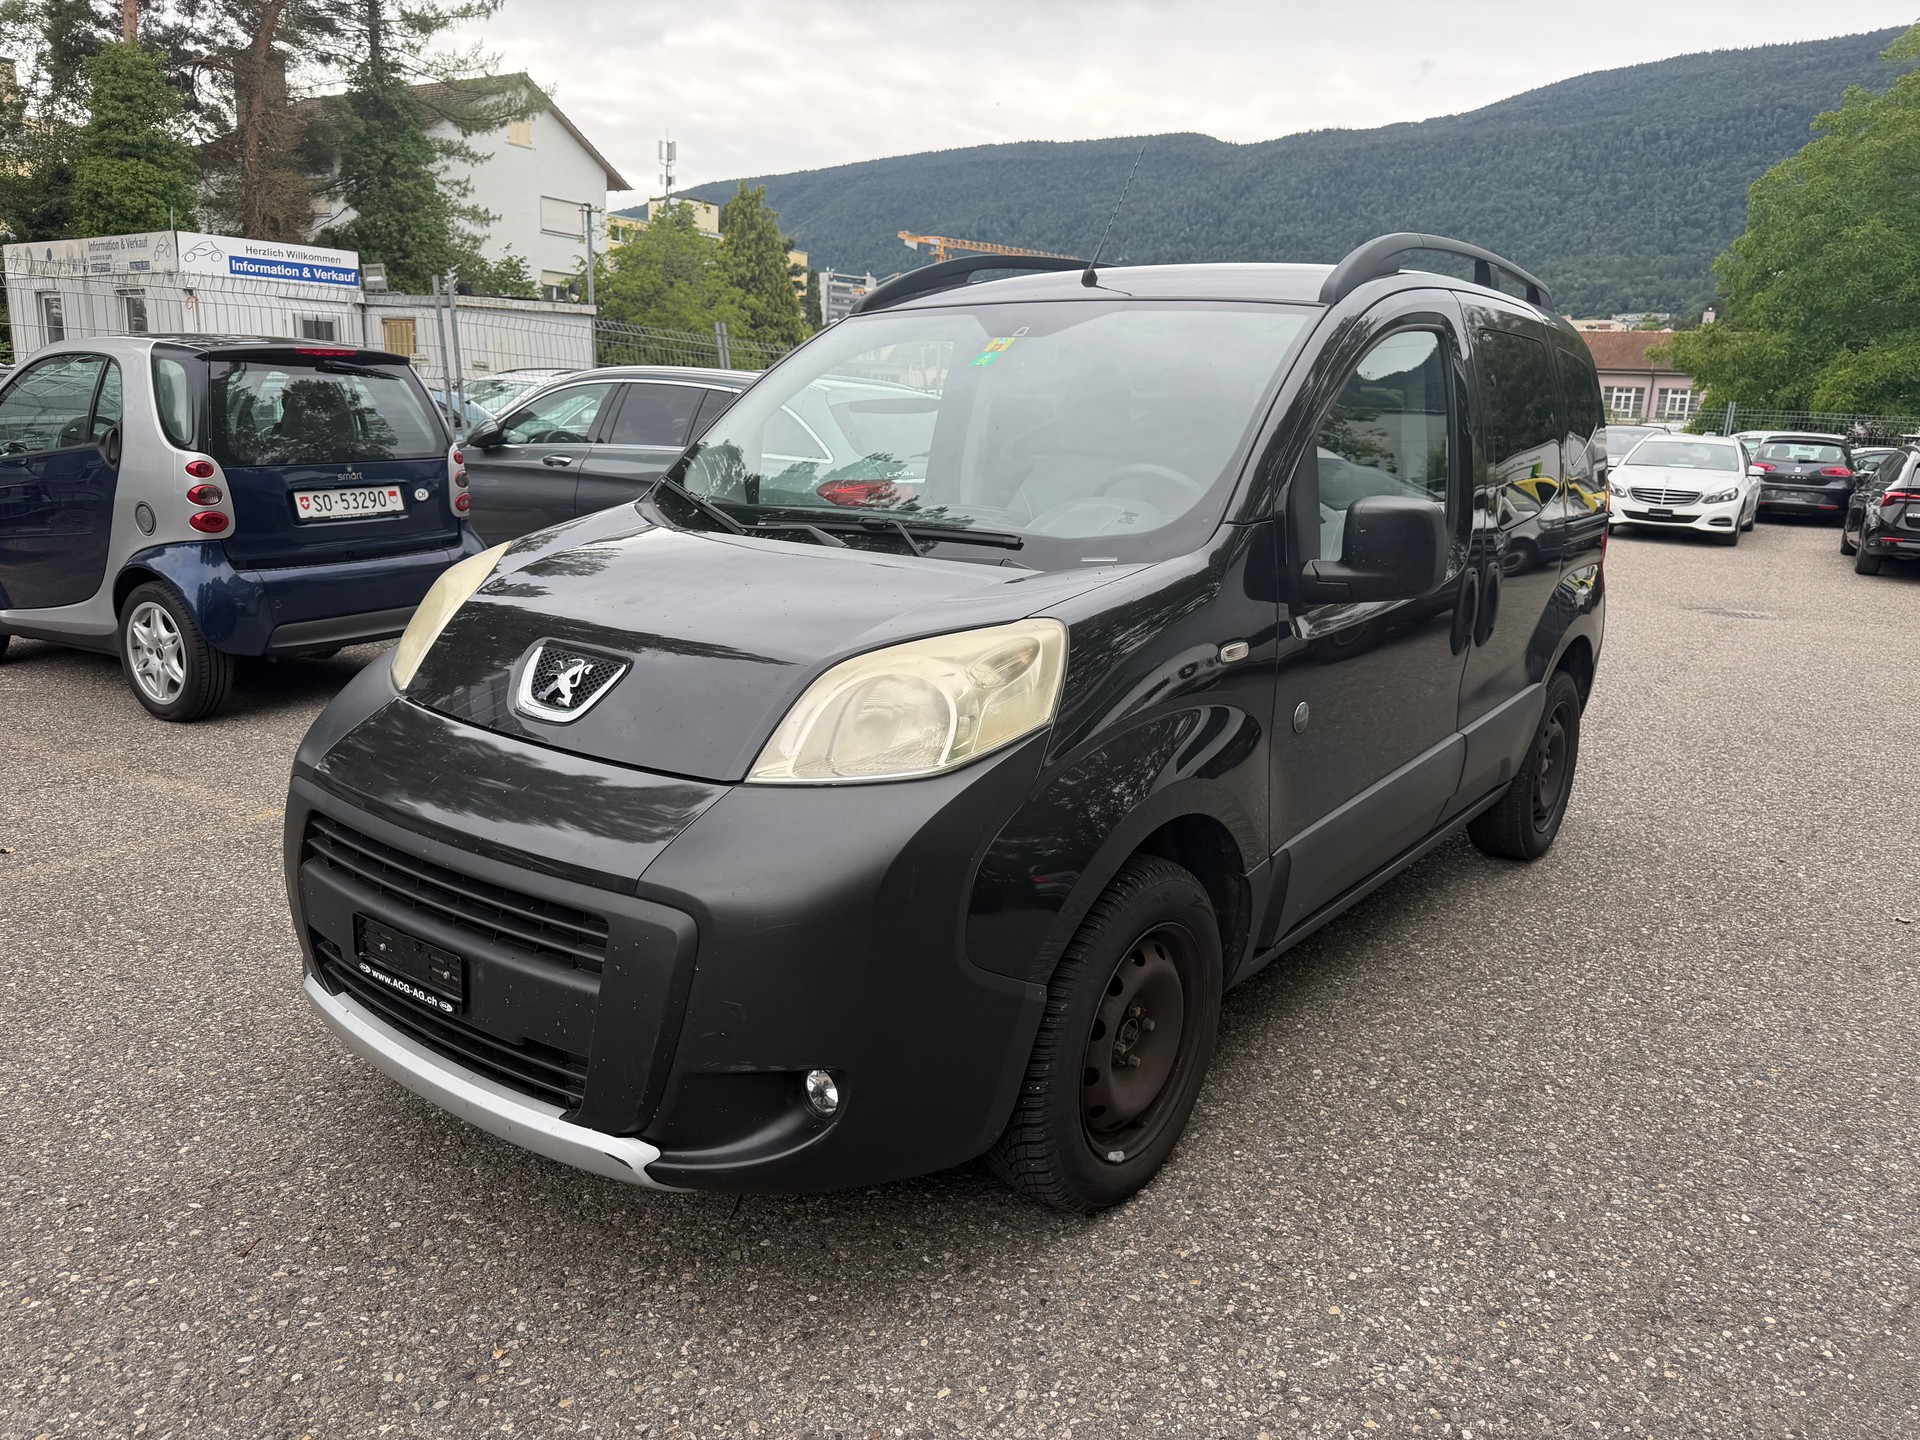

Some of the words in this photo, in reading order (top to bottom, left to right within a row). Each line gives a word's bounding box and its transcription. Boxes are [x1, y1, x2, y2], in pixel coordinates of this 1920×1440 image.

[88, 239, 120, 252] Information
[120, 238, 125, 250] &
[125, 236, 148, 250] Verkauf
[245, 246, 284, 258] Herzlich
[285, 250, 341, 264] Willkommen
[231, 259, 300, 277] Information
[302, 267, 312, 279] &
[313, 268, 356, 283] Verkauf
[337, 471, 363, 481] smart
[417, 491, 427, 499] CH
[371, 969, 438, 1007] www.ACG-AG.ch
